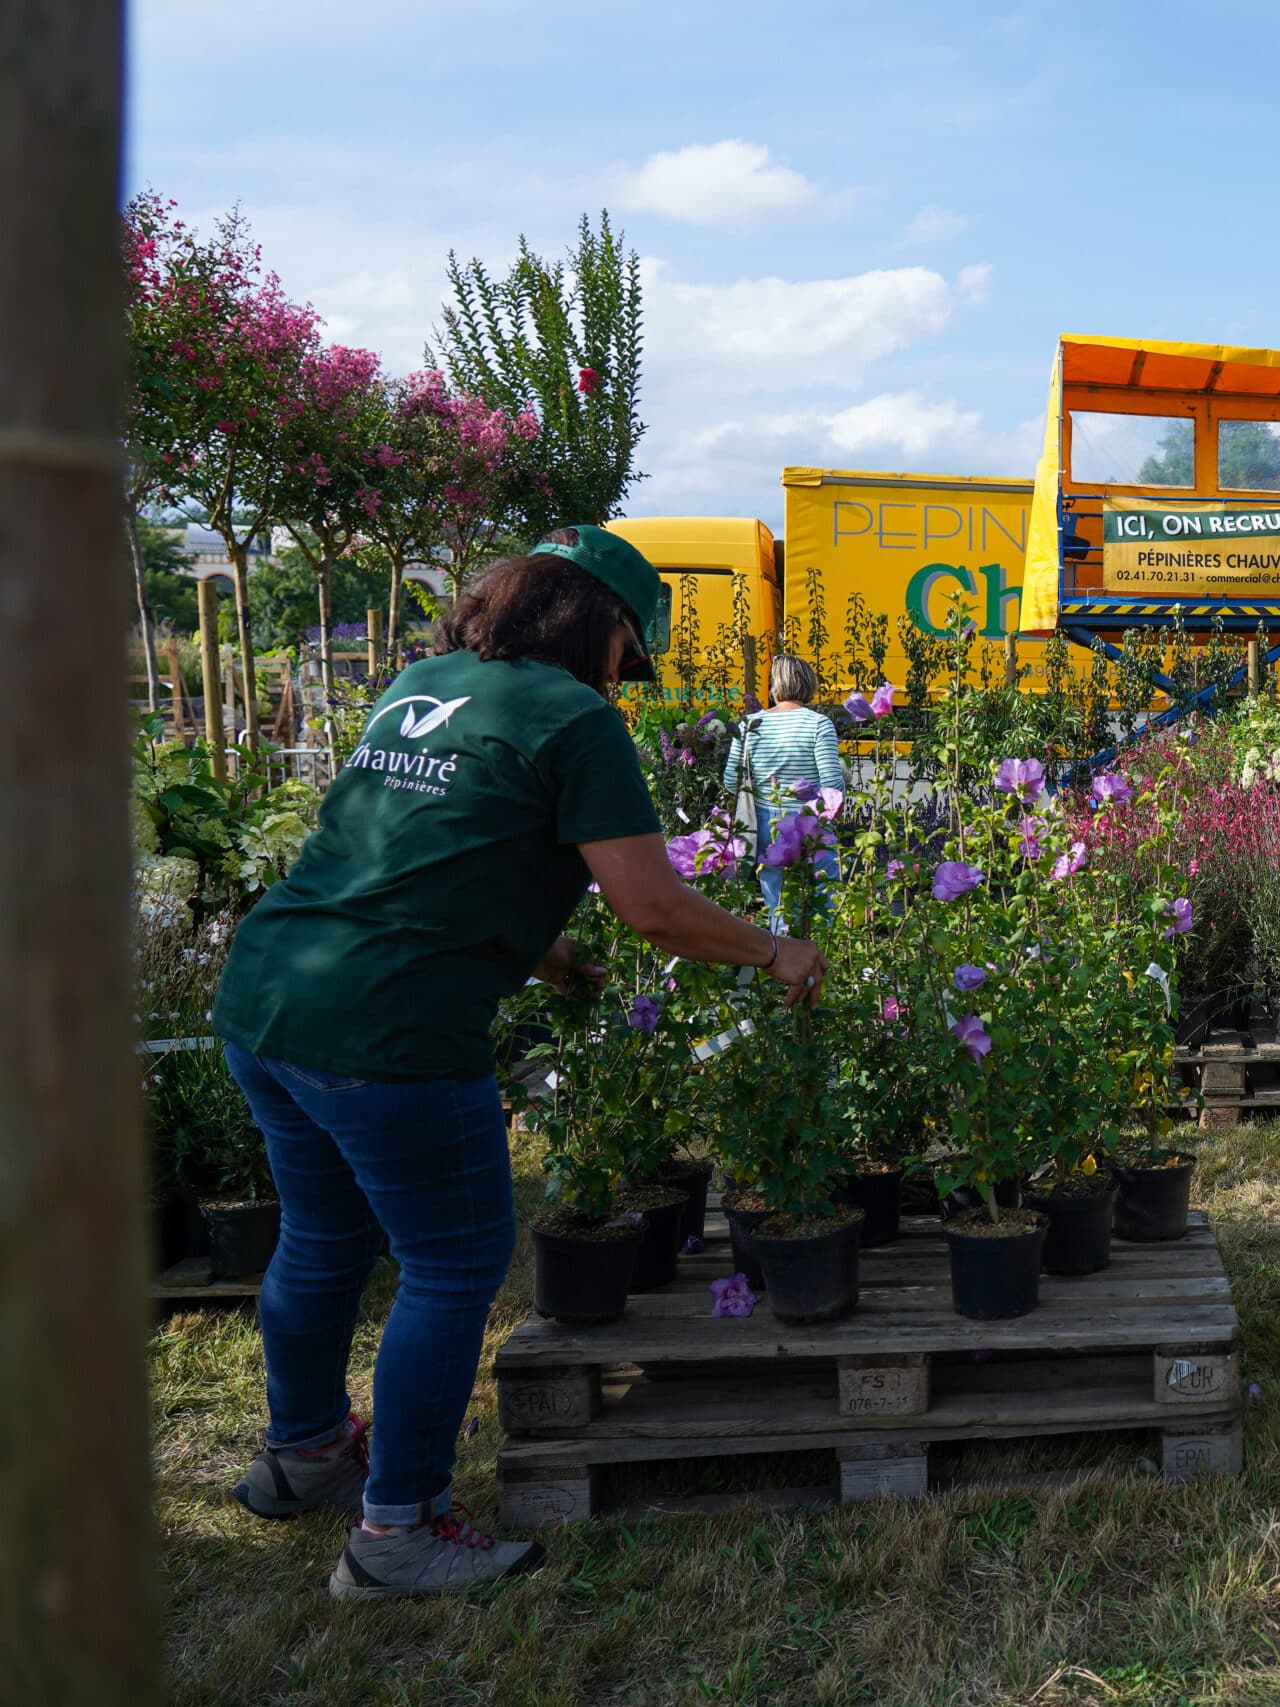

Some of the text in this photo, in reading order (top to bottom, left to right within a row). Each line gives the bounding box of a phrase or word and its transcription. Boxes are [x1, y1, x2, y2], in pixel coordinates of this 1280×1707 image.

[1117, 515, 1155, 540] ICI,
[1162, 515, 1203, 536] ON
[1138, 549, 1221, 568] PÉPINIÈRES
[1117, 570, 1195, 582] 02.41.70.21.31
[384, 775, 449, 796] Pépinières
